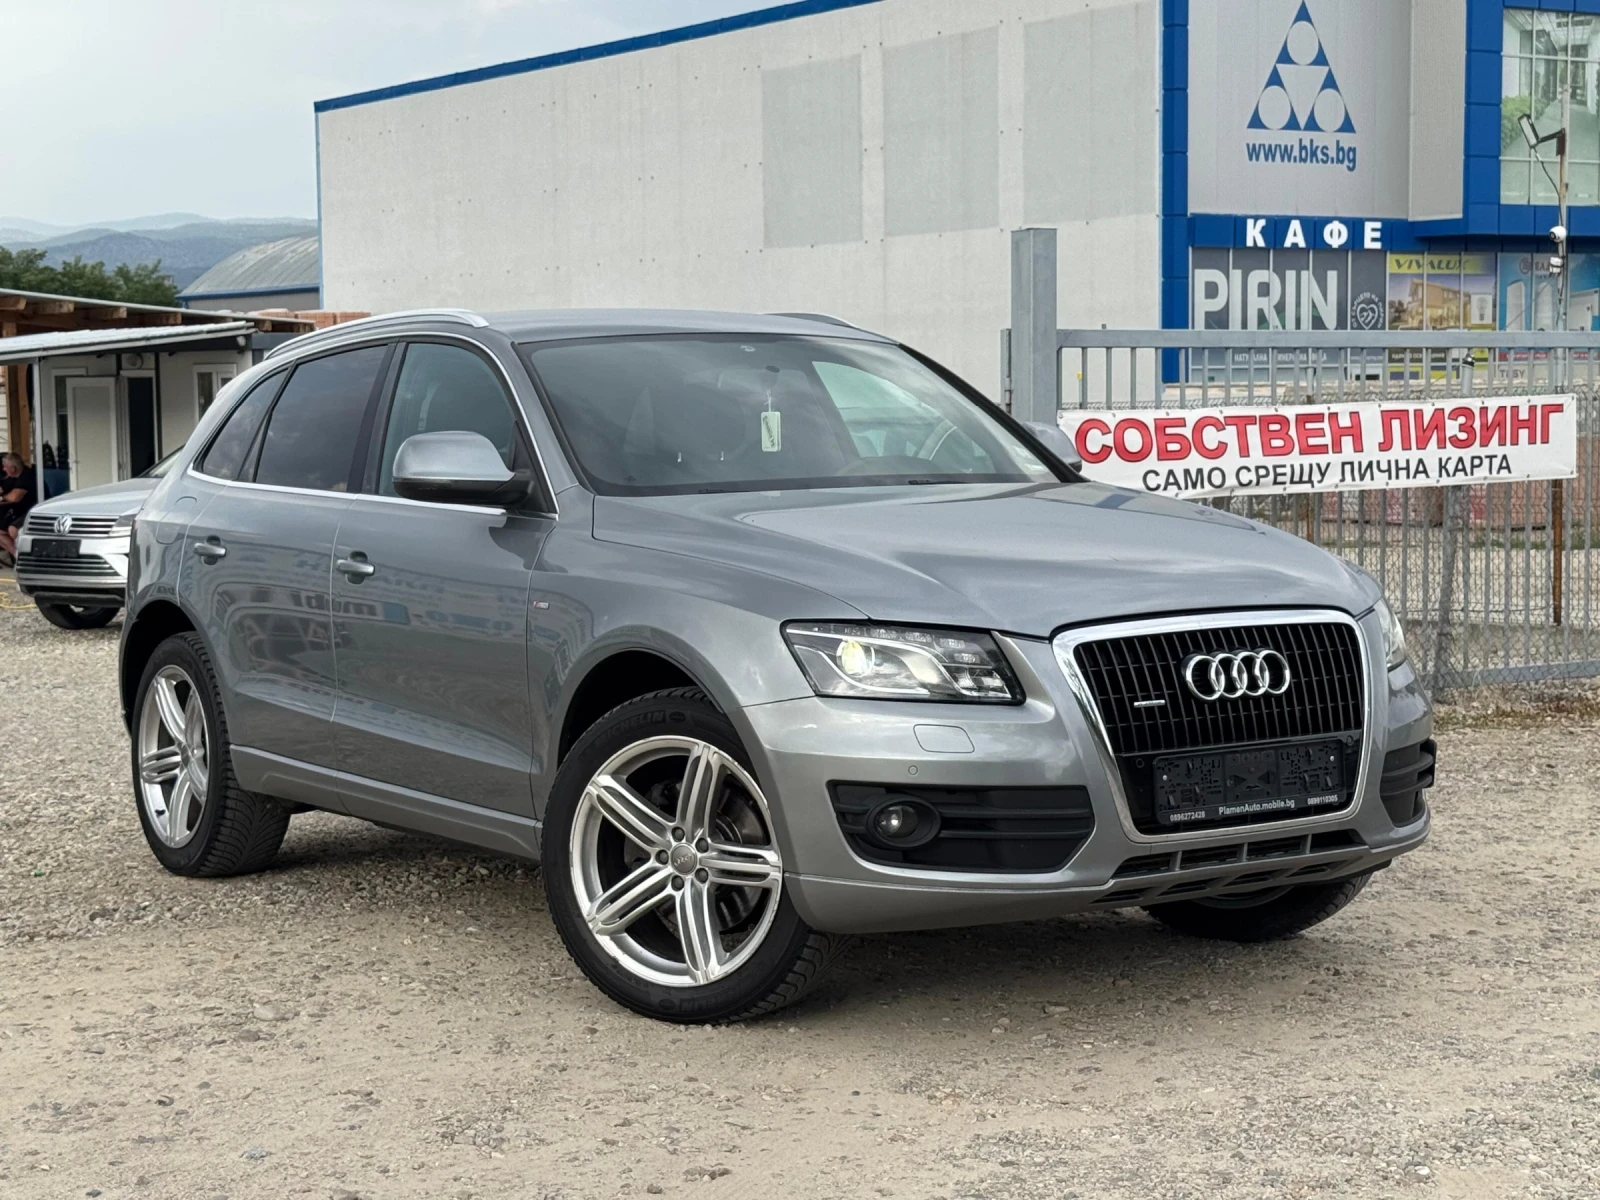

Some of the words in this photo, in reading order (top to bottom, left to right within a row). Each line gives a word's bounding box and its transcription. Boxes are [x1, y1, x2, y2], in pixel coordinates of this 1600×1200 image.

[1246, 139, 1357, 172] www.bks.bg
[1245, 217, 1383, 249] КАФЕ
[1395, 258, 1470, 270] VIVALUX
[1194, 268, 1338, 331] PIRIN
[1234, 353, 1268, 362] НАТУАЛНА
[1075, 413, 1365, 463] СОБСТВЕН
[1378, 403, 1564, 453] ЛИЗИНГ
[1142, 465, 1228, 492] САМО
[1235, 461, 1331, 488] СРЕЩУ
[1337, 456, 1430, 483] ЛИЧНА
[1437, 453, 1513, 478] КАРТА
[1218, 799, 1295, 815] PlamenAuto.mobile.bg
